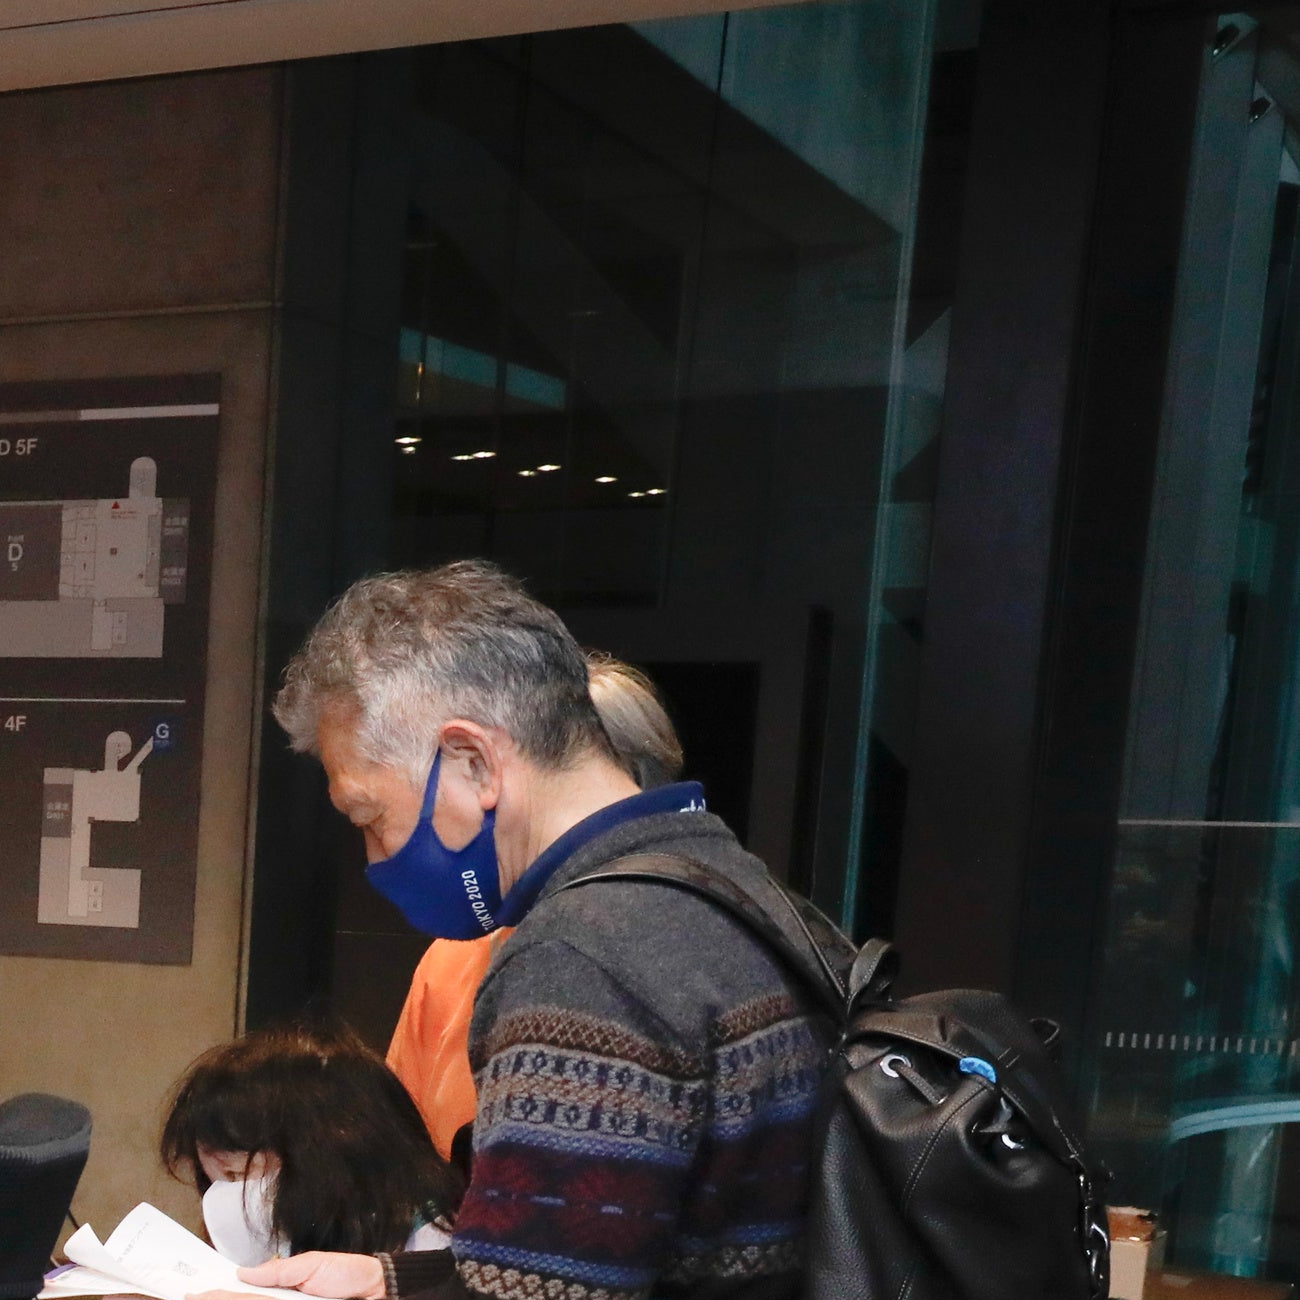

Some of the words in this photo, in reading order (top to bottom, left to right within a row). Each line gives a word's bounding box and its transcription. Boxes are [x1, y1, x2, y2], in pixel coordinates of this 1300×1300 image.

[15, 438, 38, 456] 5F
[8, 543, 24, 562] D
[4, 714, 27, 732] 4F
[155, 723, 170, 739] G
[461, 870, 482, 900] 2020
[471, 901, 495, 931] TOKYO
